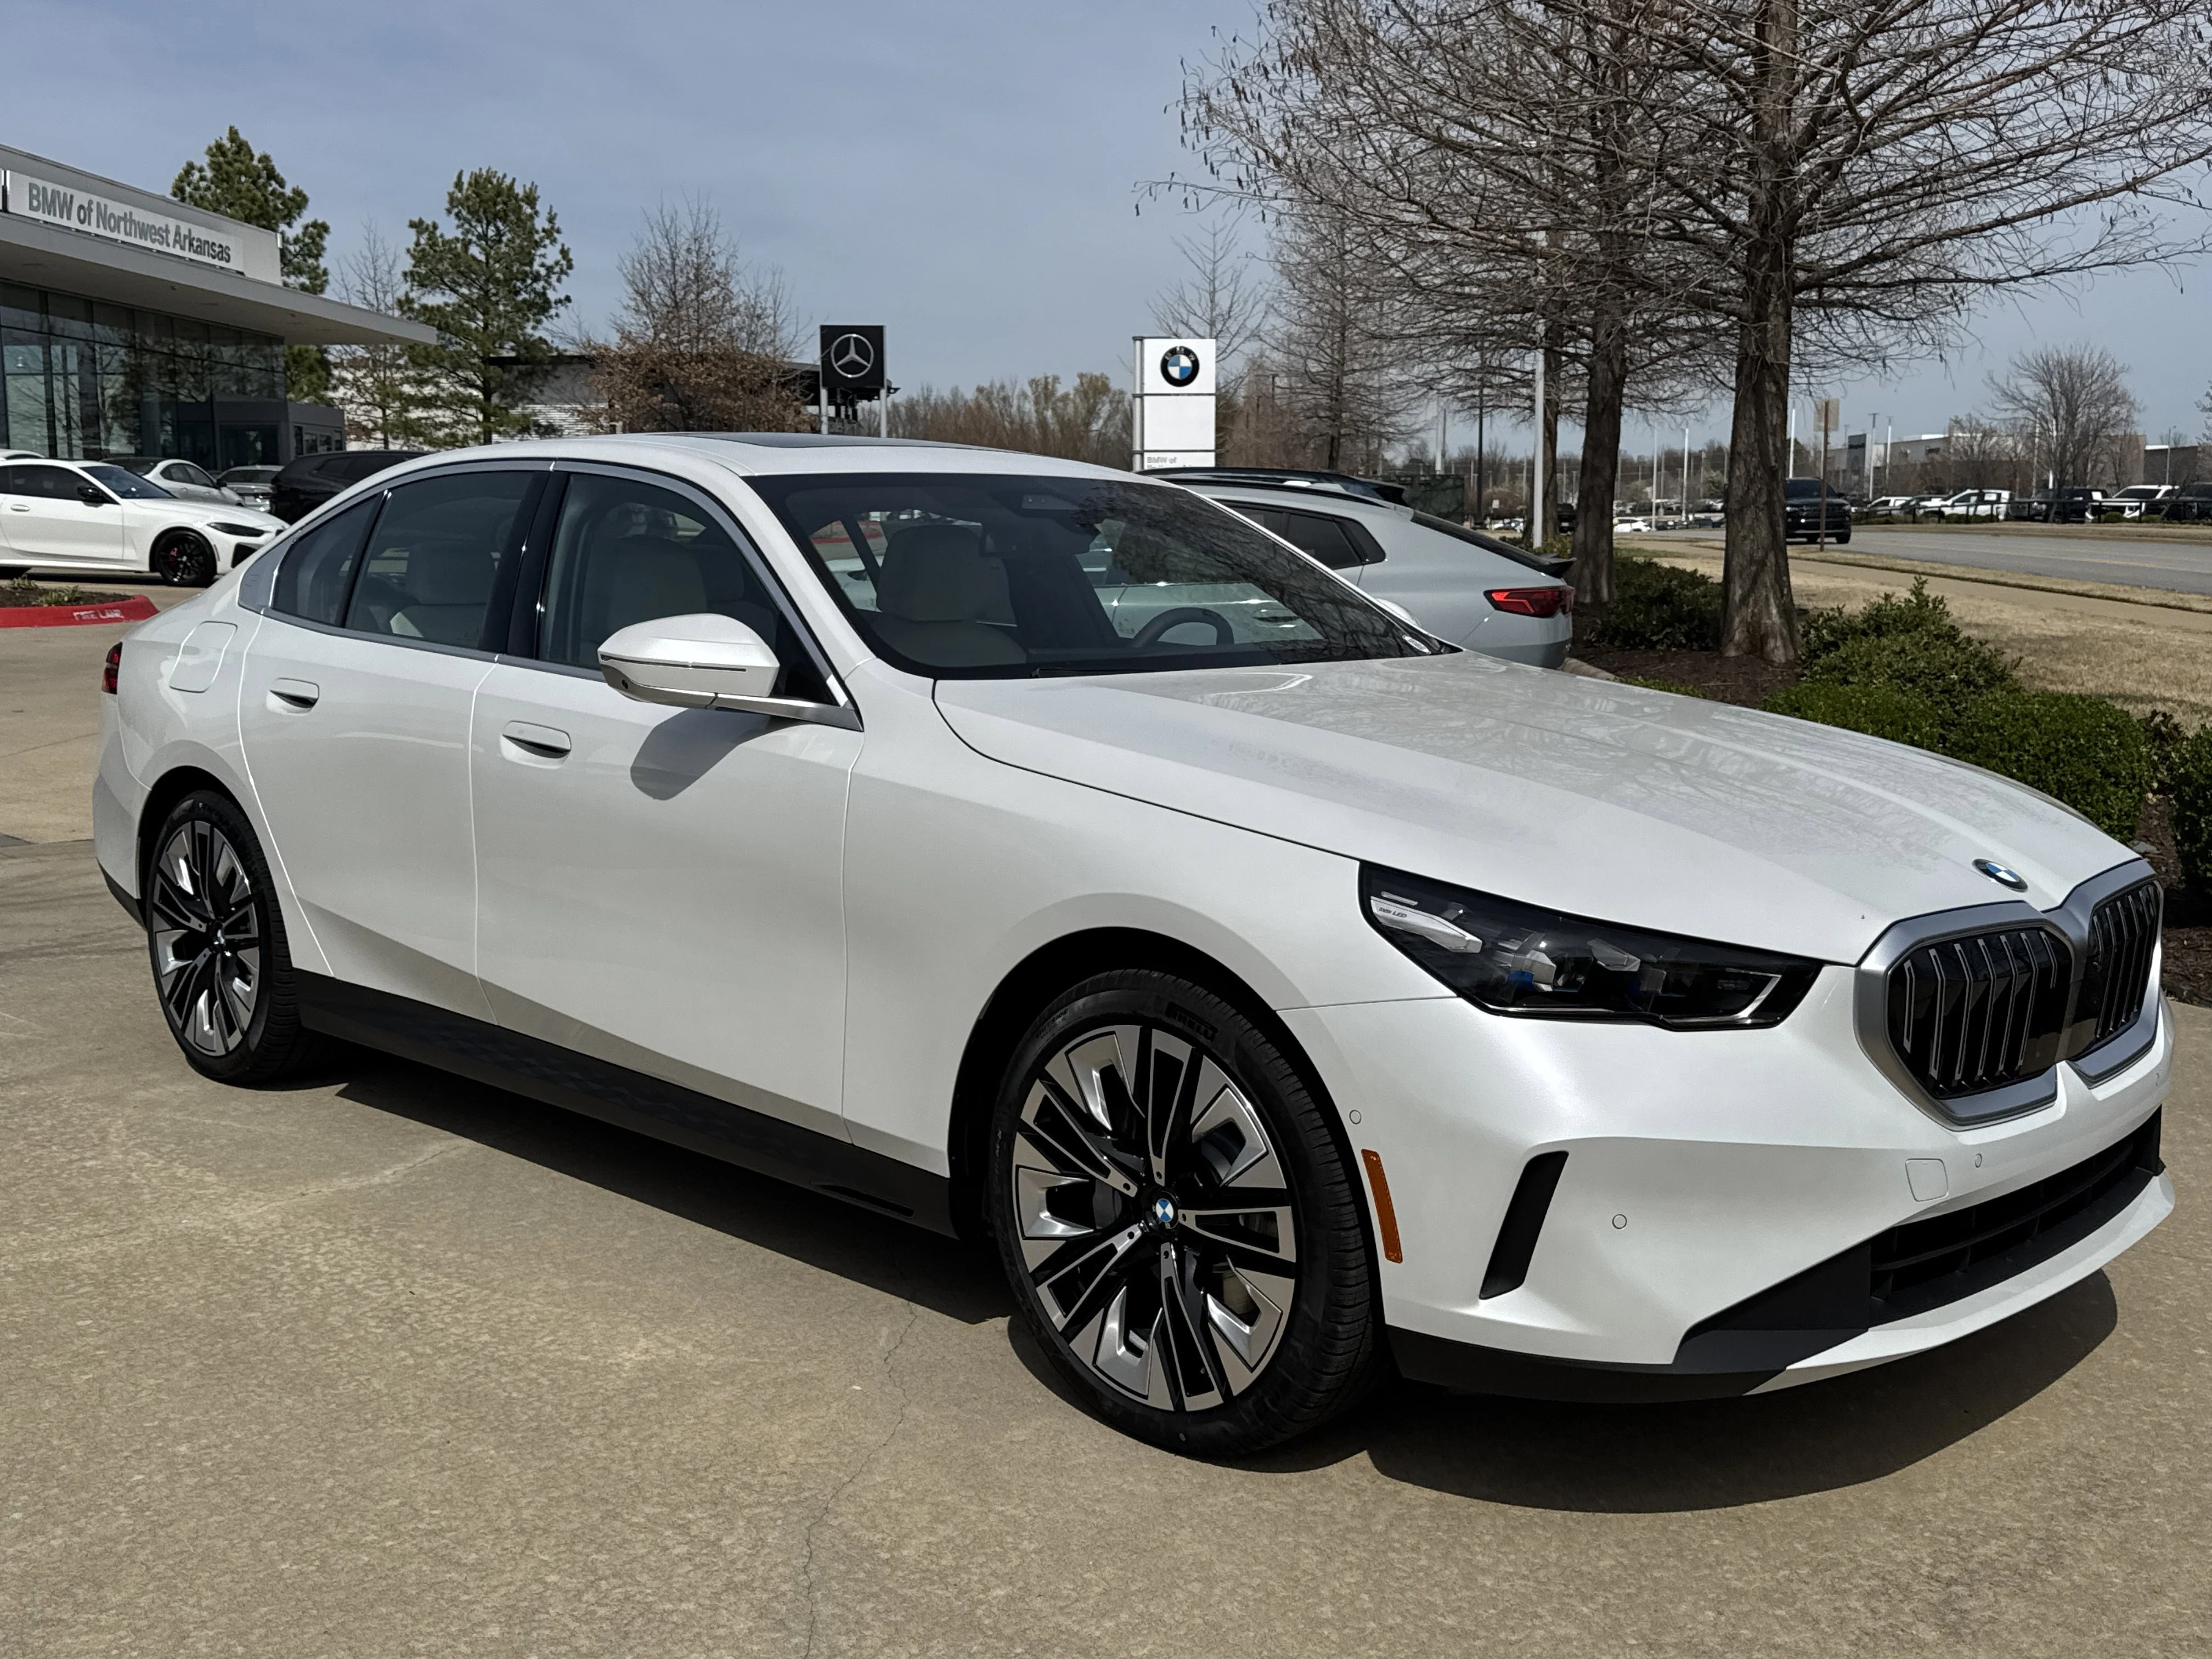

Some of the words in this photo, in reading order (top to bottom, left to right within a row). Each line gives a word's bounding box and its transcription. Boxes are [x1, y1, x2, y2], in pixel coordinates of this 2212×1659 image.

[29, 182, 74, 221] BMW
[77, 199, 93, 226] of
[96, 201, 170, 247] Northwest
[173, 225, 231, 263] Arkansas
